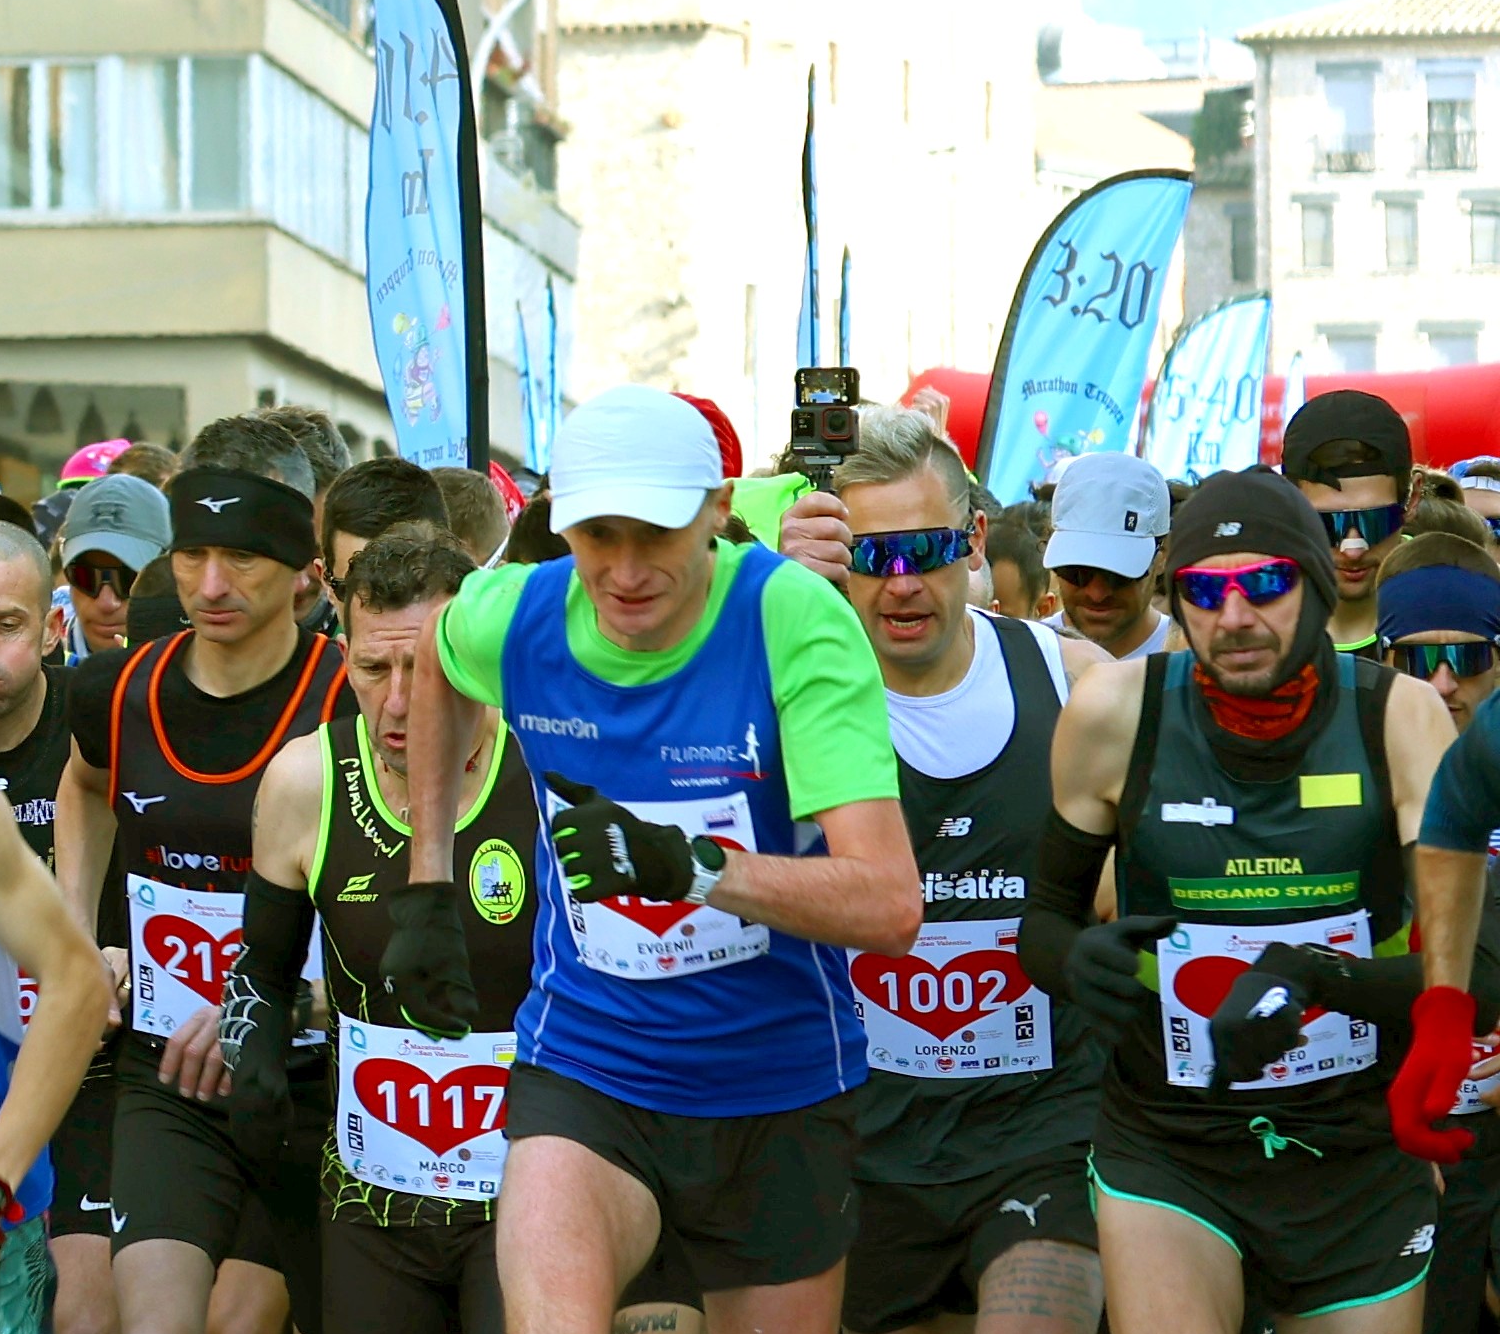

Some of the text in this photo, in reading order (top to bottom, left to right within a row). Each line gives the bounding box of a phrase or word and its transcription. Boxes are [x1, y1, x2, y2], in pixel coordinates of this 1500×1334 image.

[1042, 238, 1158, 330] 3:20
[1021, 376, 1124, 426] Marathon Truppen
[1225, 857, 1304, 876] ATLETICA
[336, 893, 379, 903] GIOSPORT
[1173, 880, 1356, 900] BERGAMO STARS
[636, 938, 695, 956] EVGENII
[878, 969, 1009, 1013] 1002
[914, 1045, 977, 1056] LORENZO
[377, 1080, 506, 1130] 1117
[419, 1160, 465, 1174] MARCO
